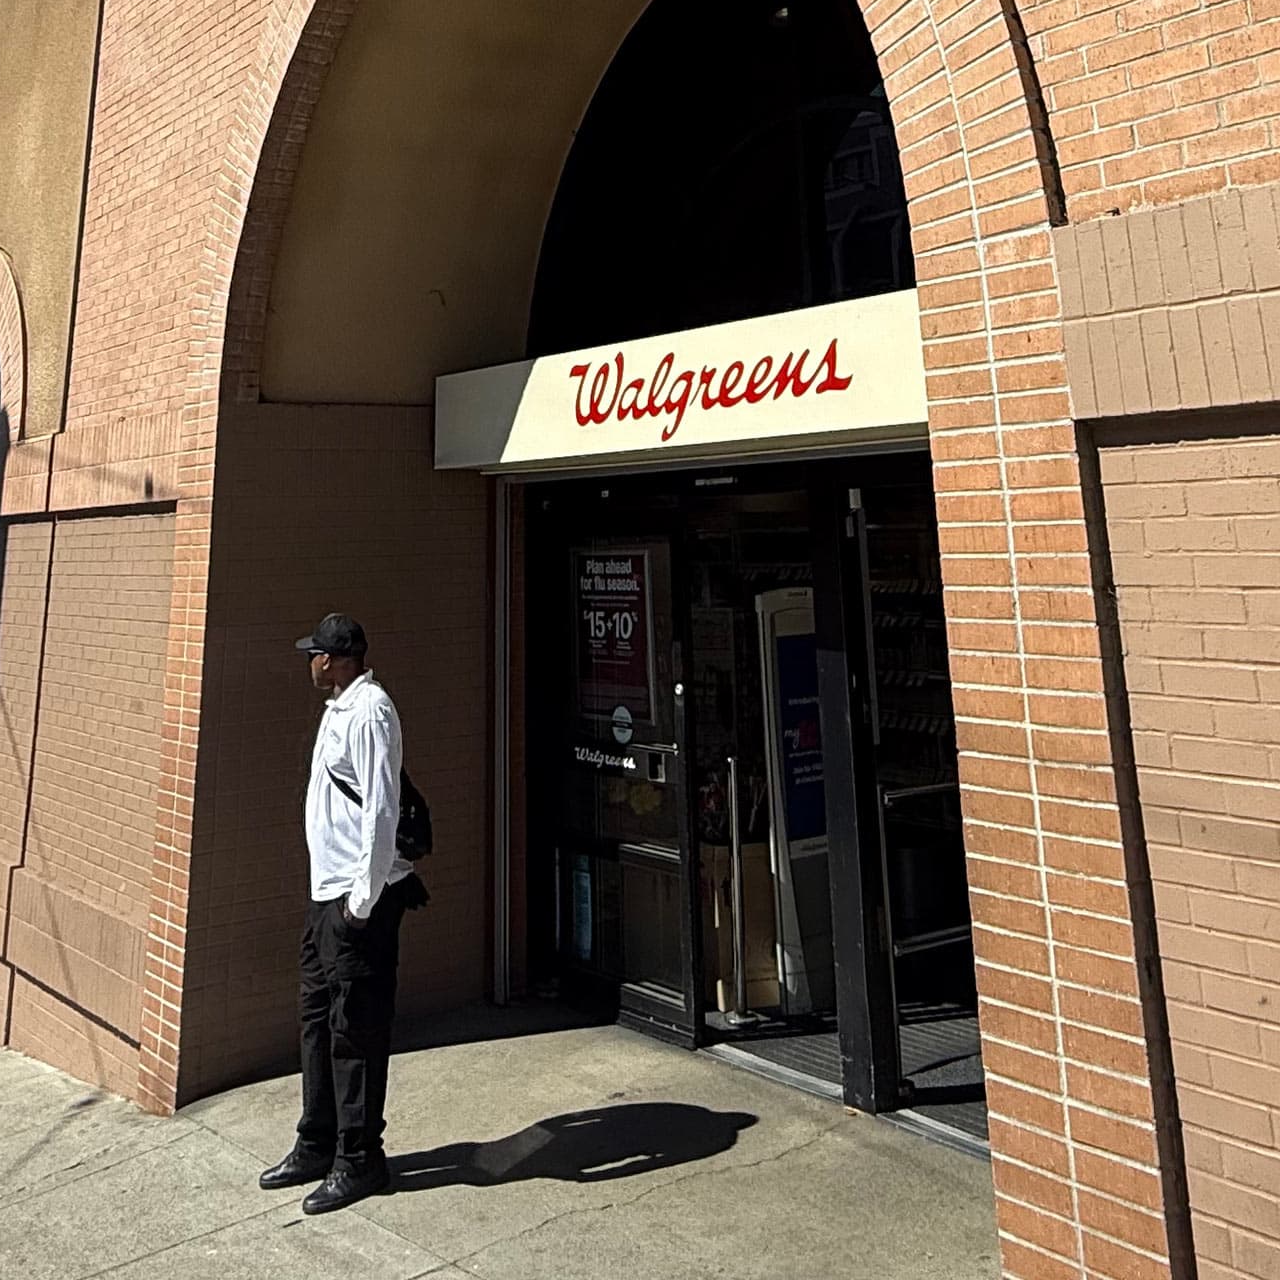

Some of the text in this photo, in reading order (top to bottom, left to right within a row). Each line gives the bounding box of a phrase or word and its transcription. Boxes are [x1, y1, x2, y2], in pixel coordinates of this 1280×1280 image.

[569, 337, 854, 442] Walgreens
[586, 559, 632, 575] Plan ahead
[580, 576, 593, 591] for
